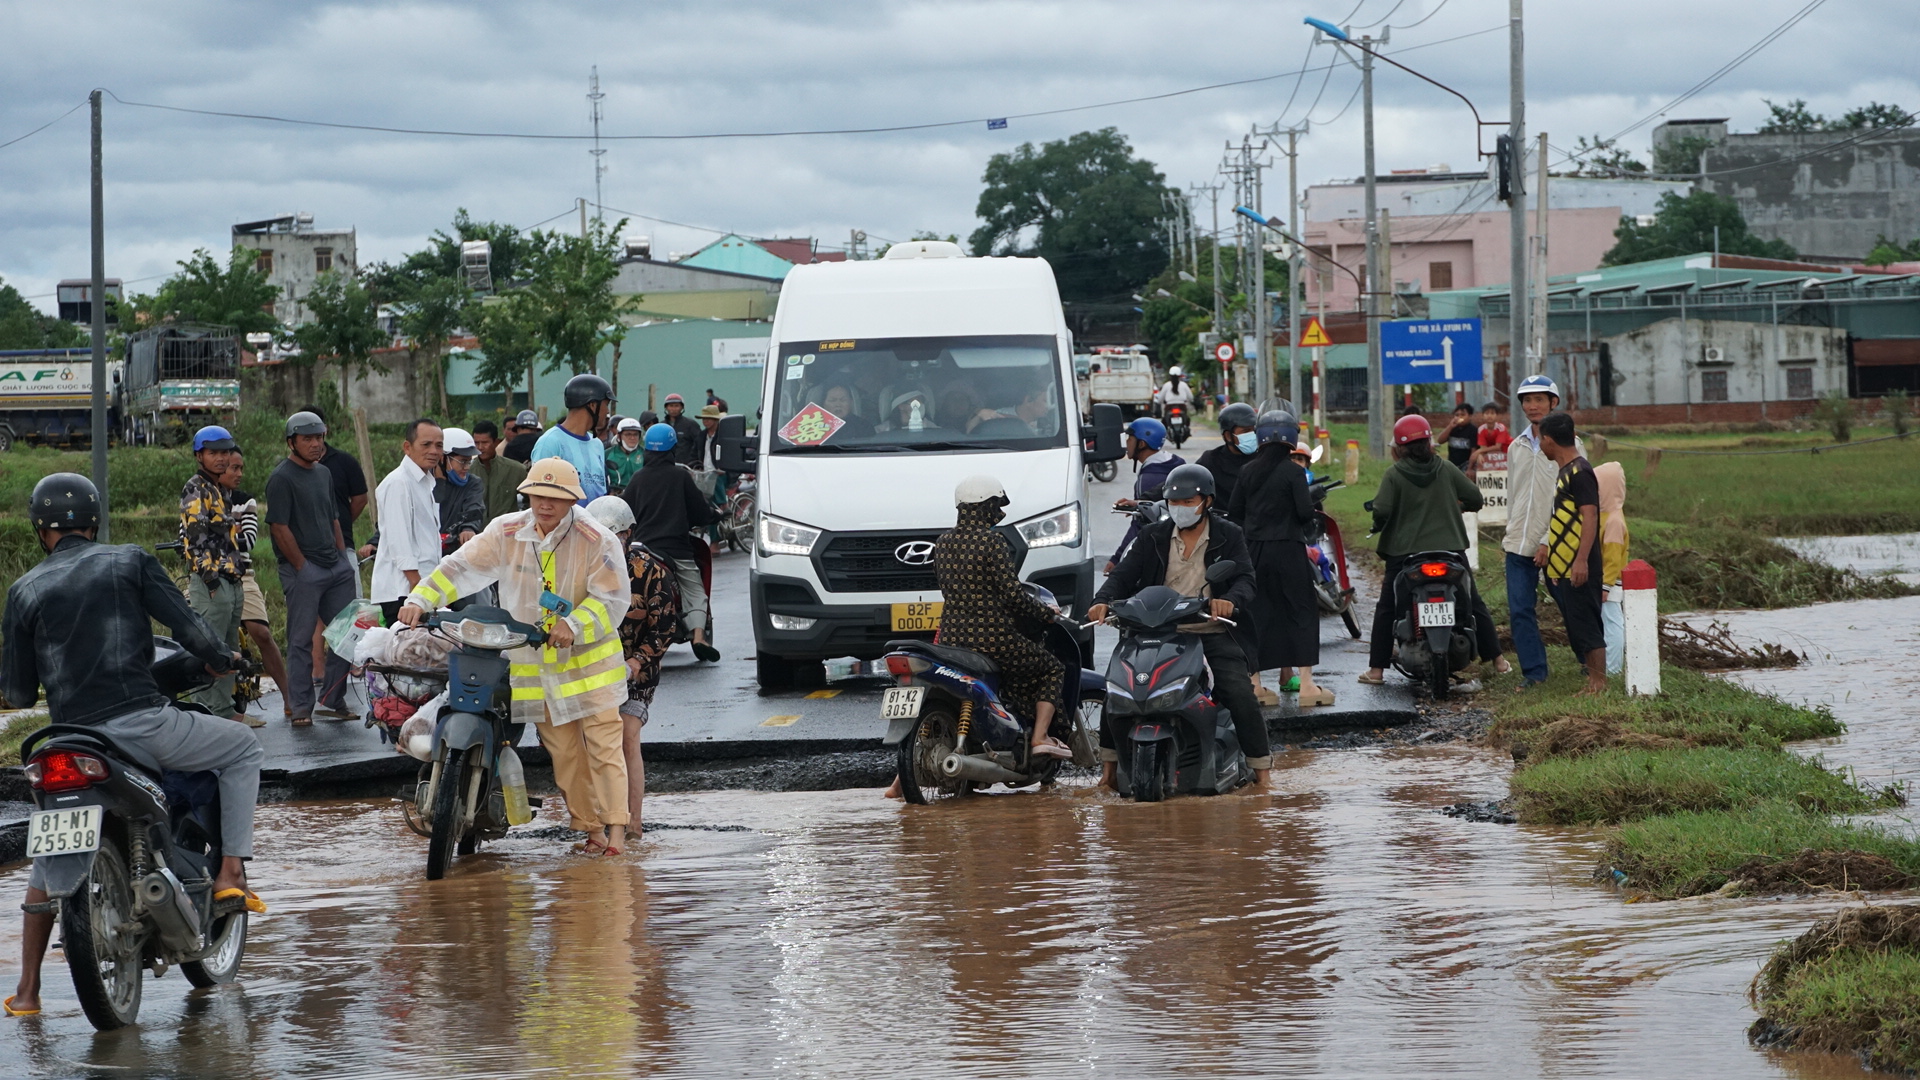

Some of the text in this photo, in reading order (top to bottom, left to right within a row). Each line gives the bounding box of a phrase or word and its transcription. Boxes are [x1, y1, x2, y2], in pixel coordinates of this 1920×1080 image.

[1462, 323, 1472, 331] PA
[908, 604, 931, 616] 82F
[1421, 614, 1453, 625] 141.65
[888, 690, 918, 703] 81-K2
[886, 704, 913, 716] 3051
[41, 810, 89, 832] 81-N1
[32, 829, 95, 854] 255.98
